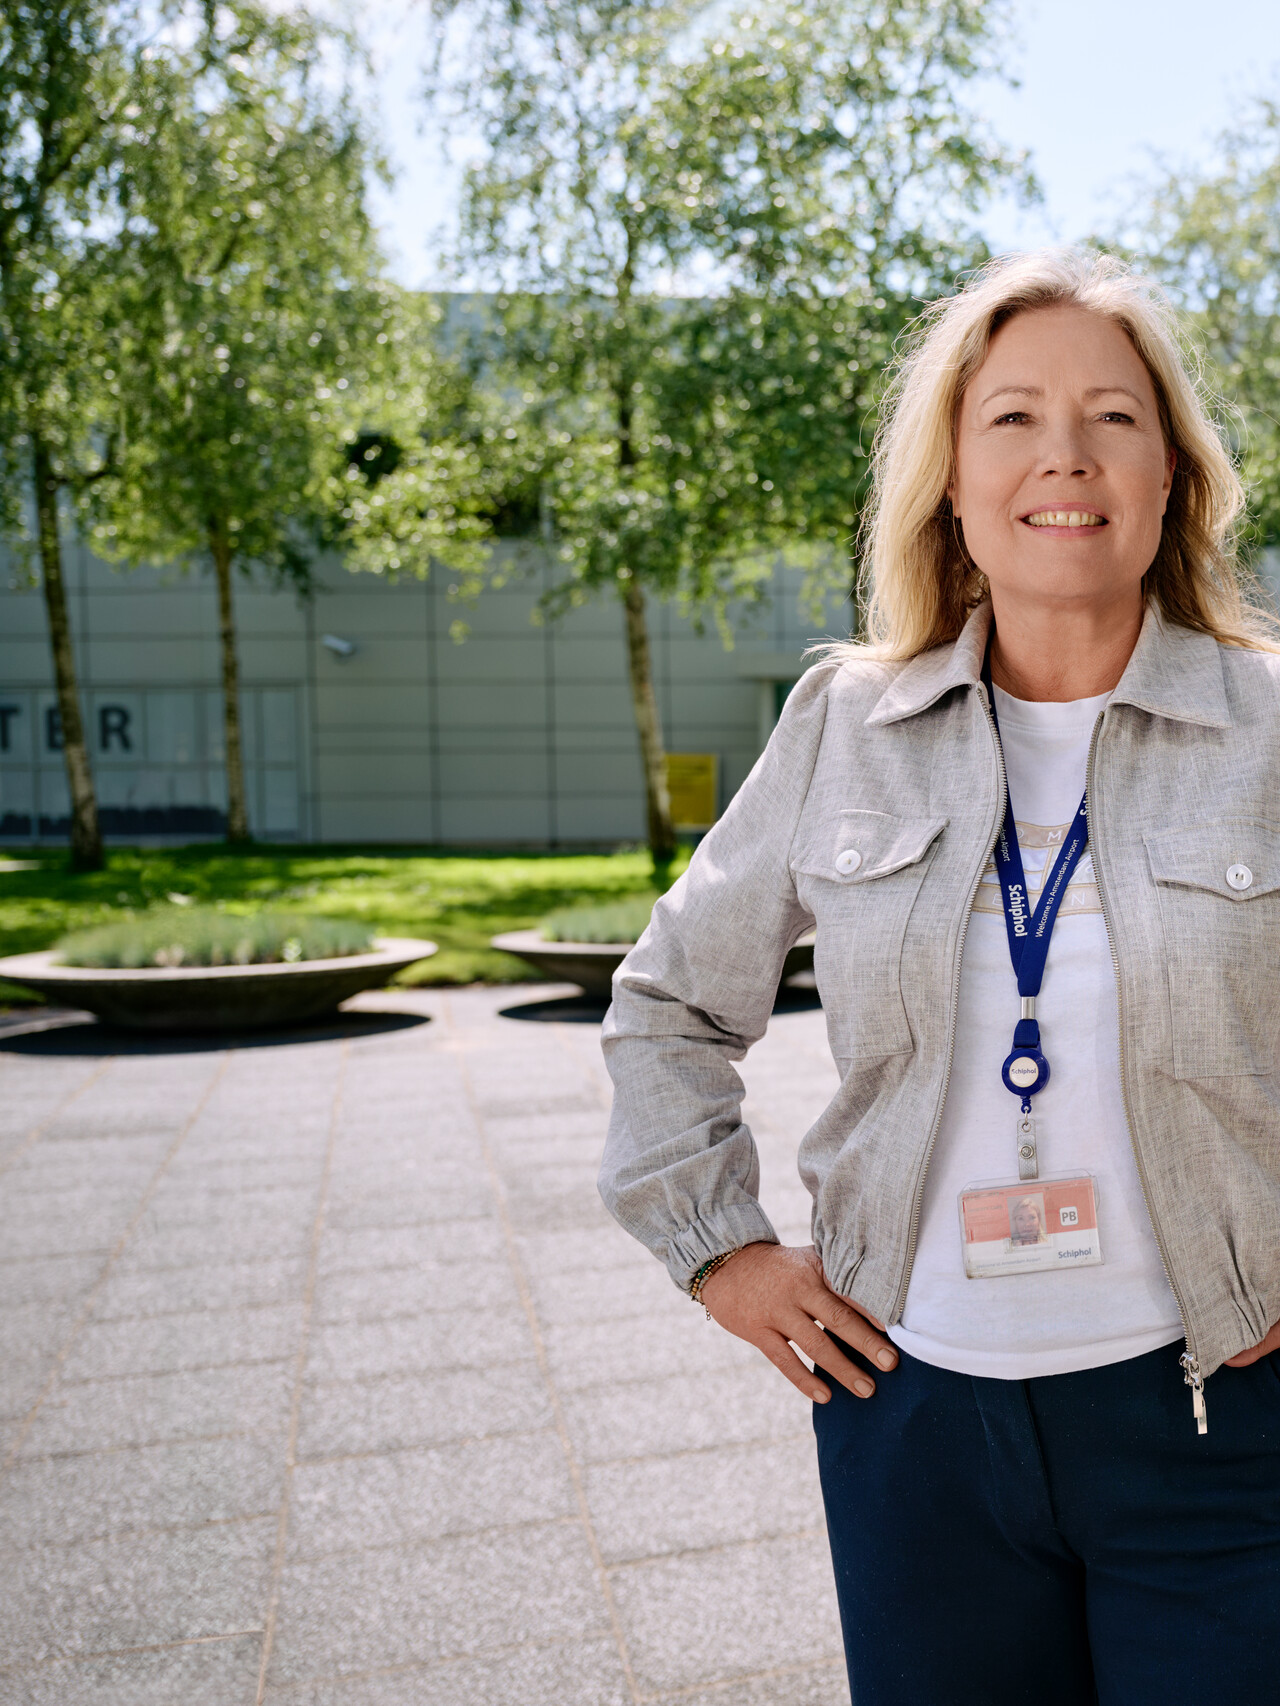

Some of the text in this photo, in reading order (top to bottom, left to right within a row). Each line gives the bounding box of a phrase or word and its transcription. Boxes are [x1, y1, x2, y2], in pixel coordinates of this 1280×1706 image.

[1035, 839, 1080, 938] Welcome to Amsterdam Airport
[1008, 884, 1028, 937] Schiphol
[1062, 1211, 1077, 1222] PB
[1058, 1248, 1092, 1259] Schiphol
